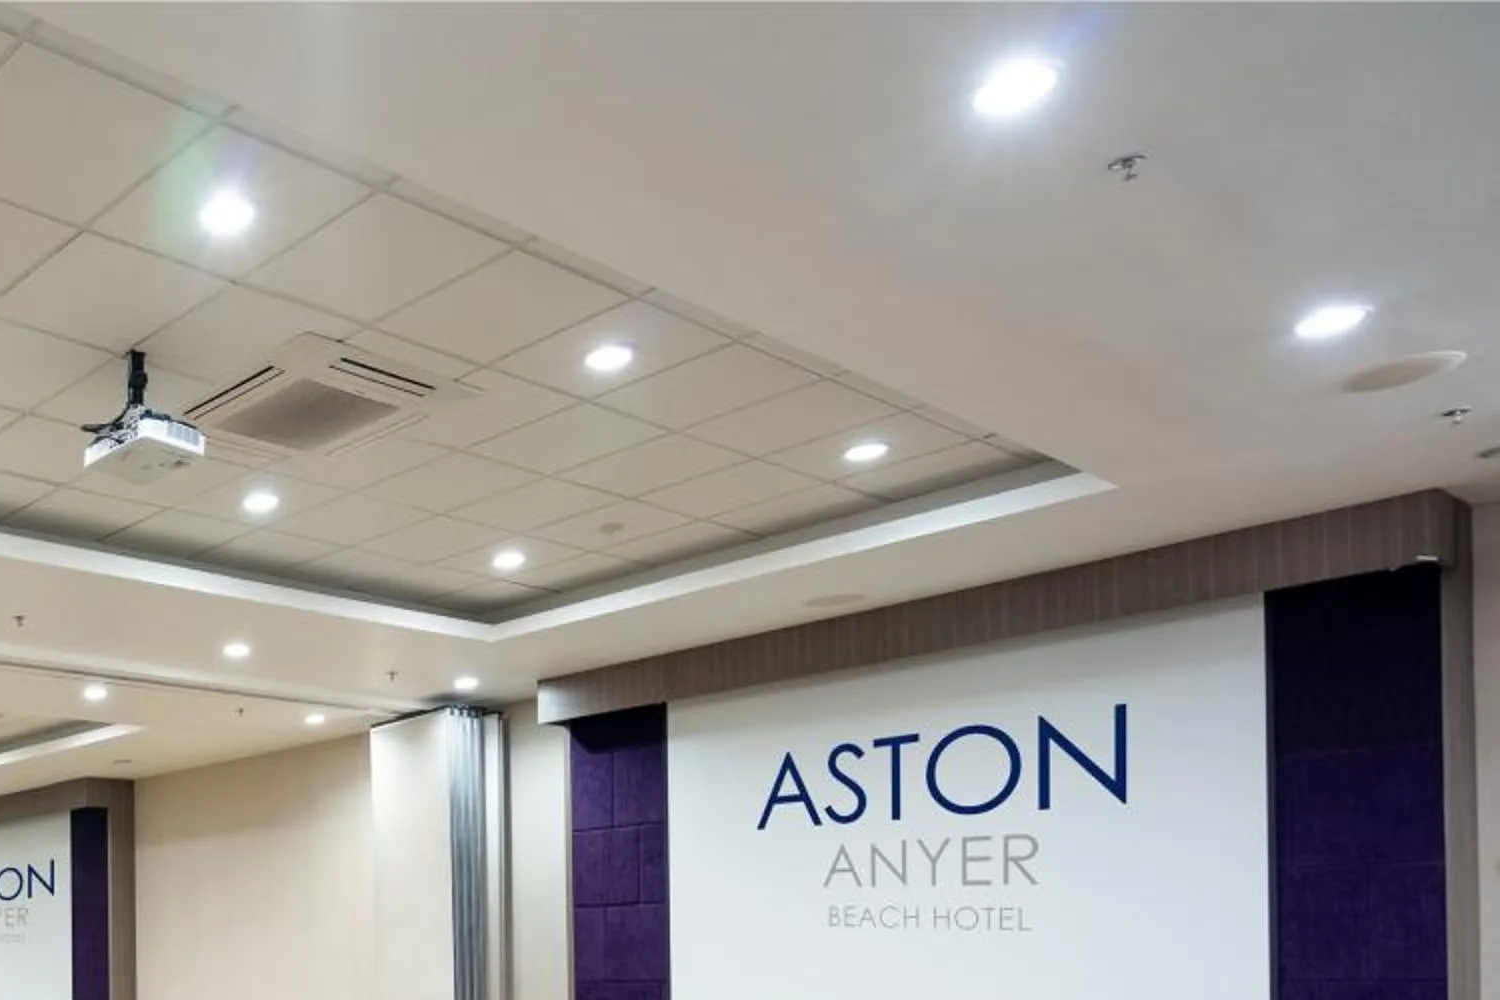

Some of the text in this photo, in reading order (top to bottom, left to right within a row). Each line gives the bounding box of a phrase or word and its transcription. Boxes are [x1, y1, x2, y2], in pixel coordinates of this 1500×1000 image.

[757, 703, 1127, 830] ASTON
[823, 833, 1040, 888] ANYER
[827, 905, 1032, 932] BEACH HOTEL
